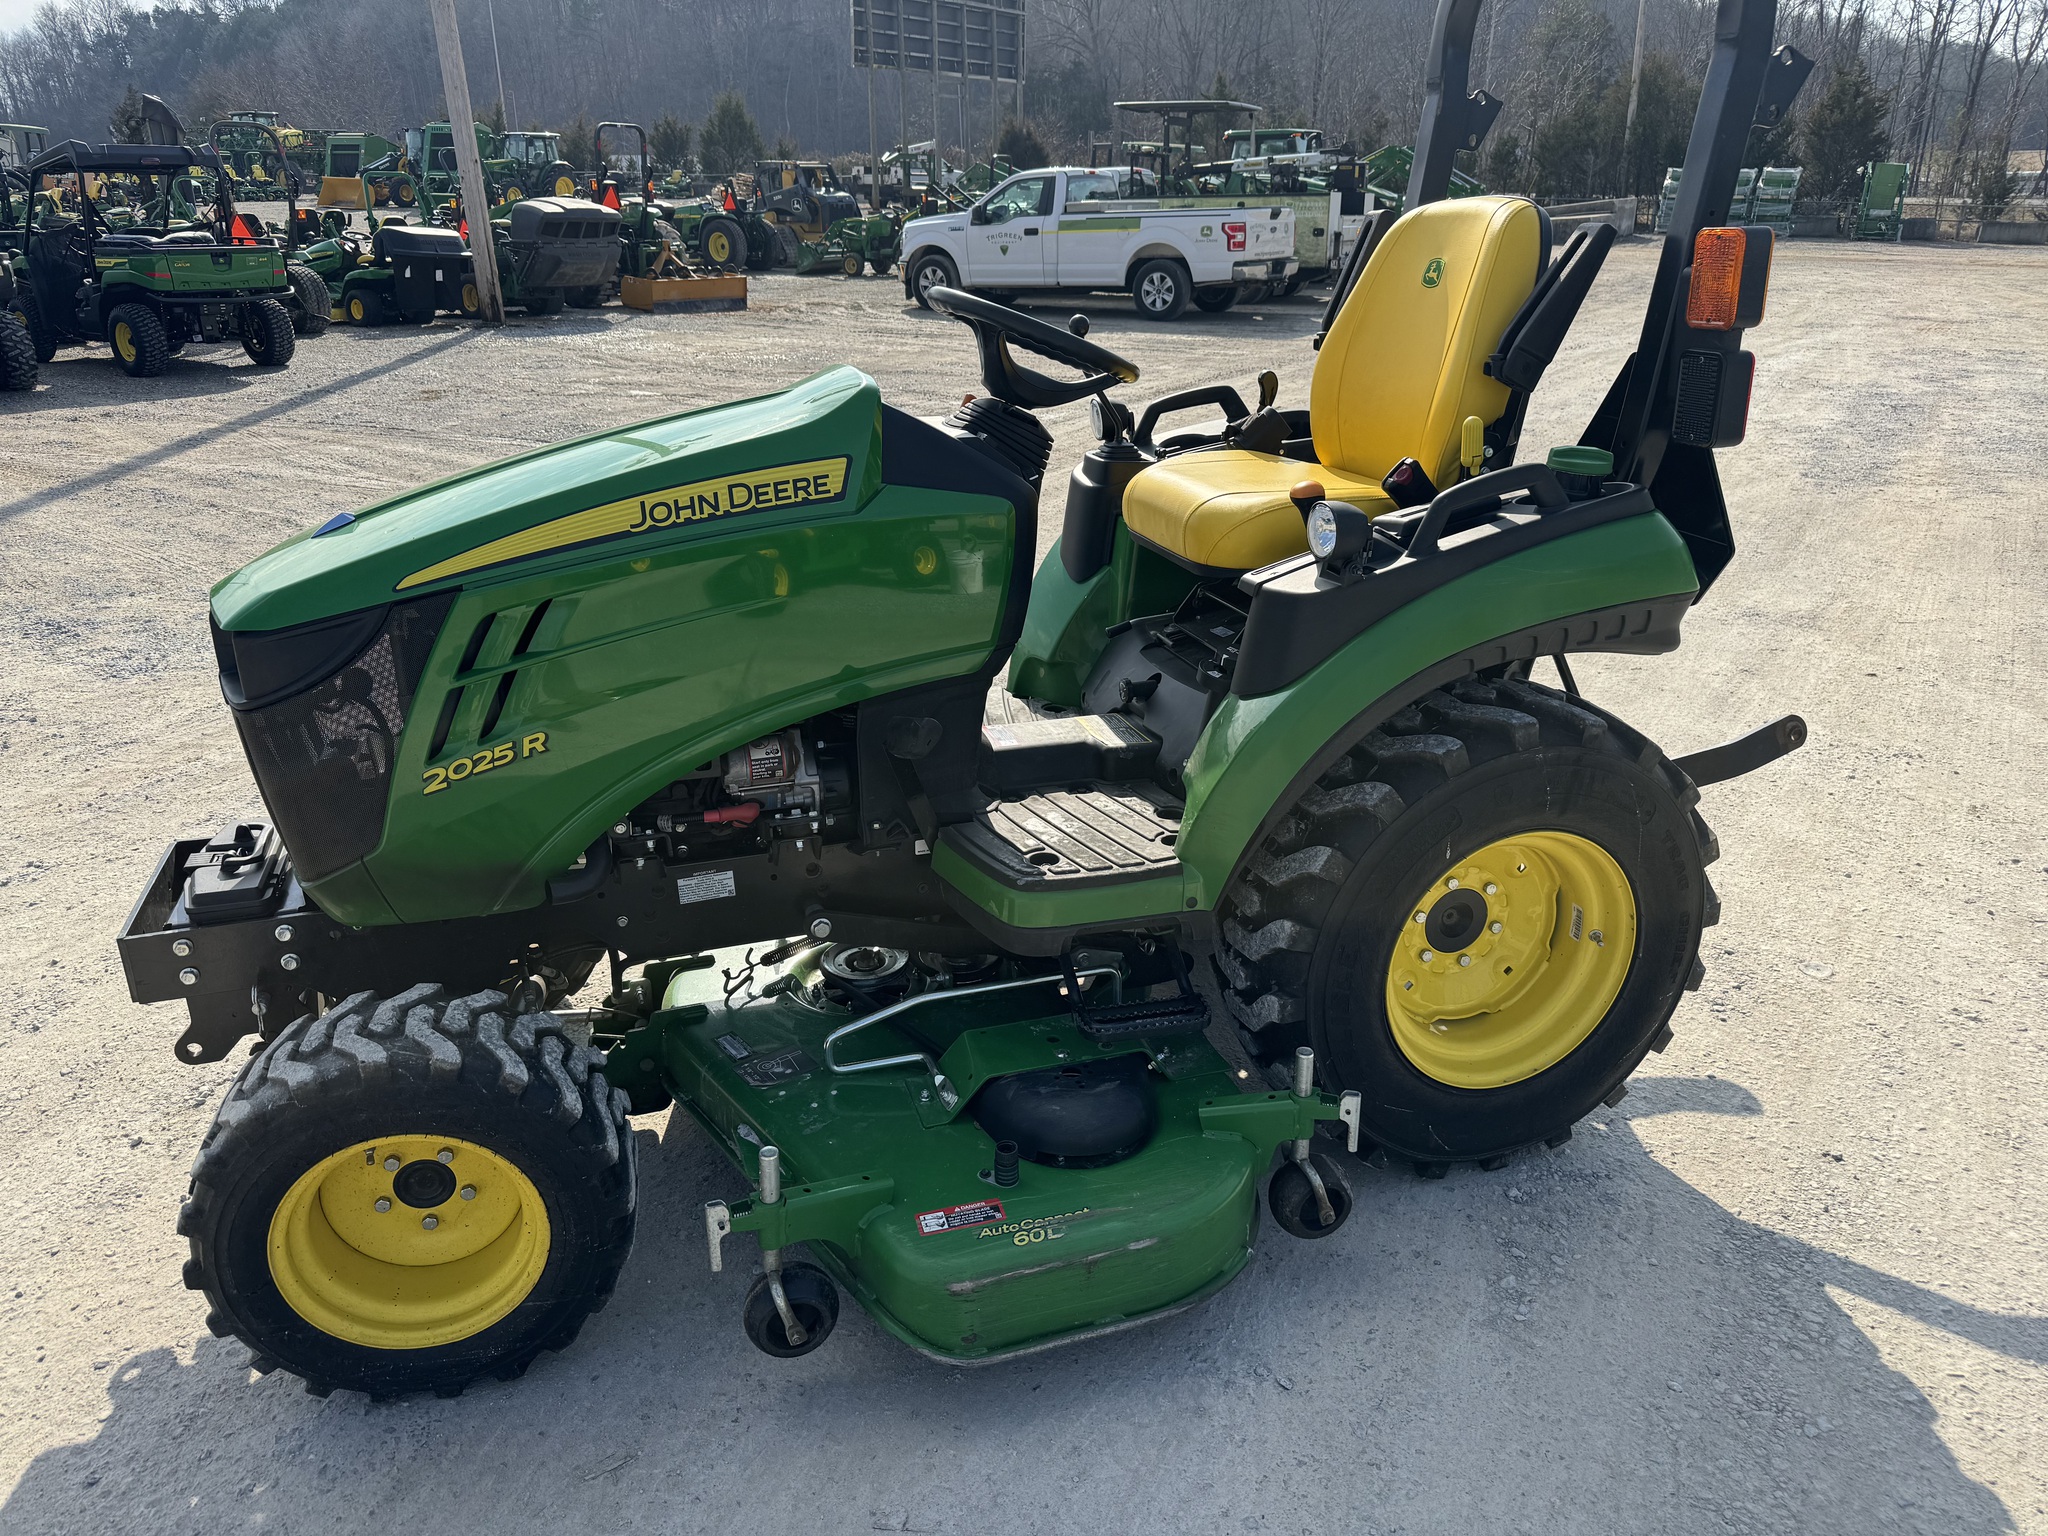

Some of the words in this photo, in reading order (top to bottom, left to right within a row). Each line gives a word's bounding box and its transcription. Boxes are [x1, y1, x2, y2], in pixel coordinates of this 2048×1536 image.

[986, 232, 1023, 241] TRIGREEN
[629, 491, 722, 531] JOHN
[727, 474, 833, 511] DEERE
[423, 741, 515, 795] 2025
[522, 731, 547, 758] R
[961, 1201, 986, 1210] DANGER
